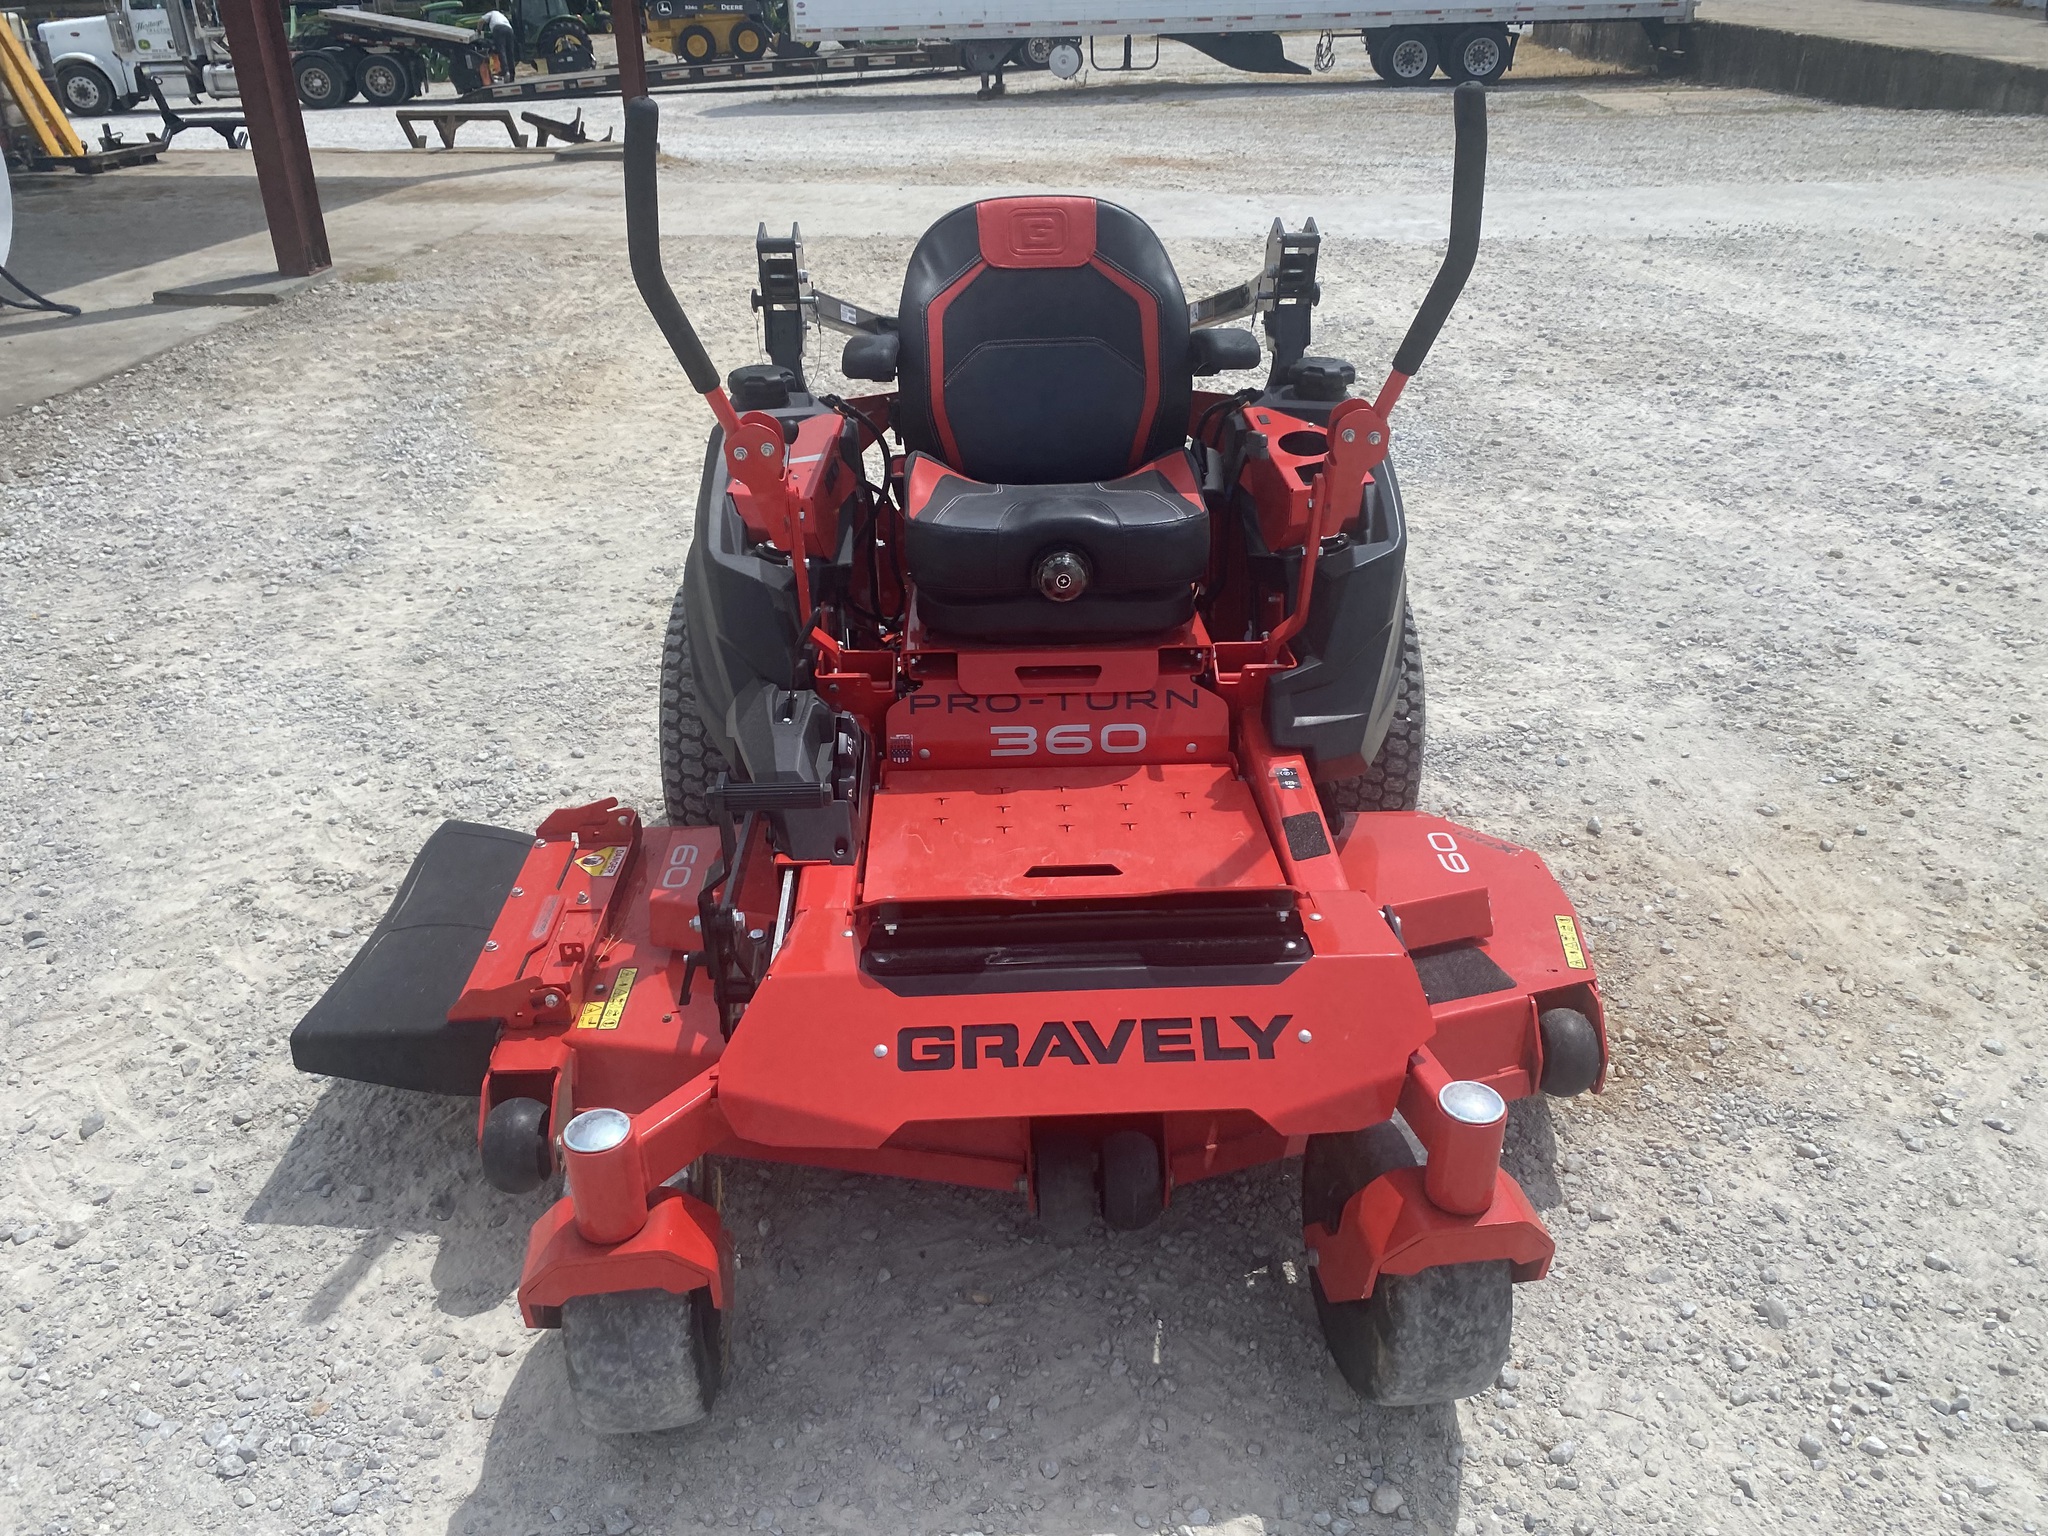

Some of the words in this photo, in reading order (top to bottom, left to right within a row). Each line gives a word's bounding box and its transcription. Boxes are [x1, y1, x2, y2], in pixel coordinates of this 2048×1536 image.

[720, 3, 744, 11] DEERE
[909, 688, 1199, 716] PRO-TURN
[989, 723, 1147, 757] 360
[603, 849, 625, 874] DANGER
[662, 844, 699, 888] 60
[1427, 832, 1470, 873] 60
[896, 1014, 1294, 1072] GRAVELY
